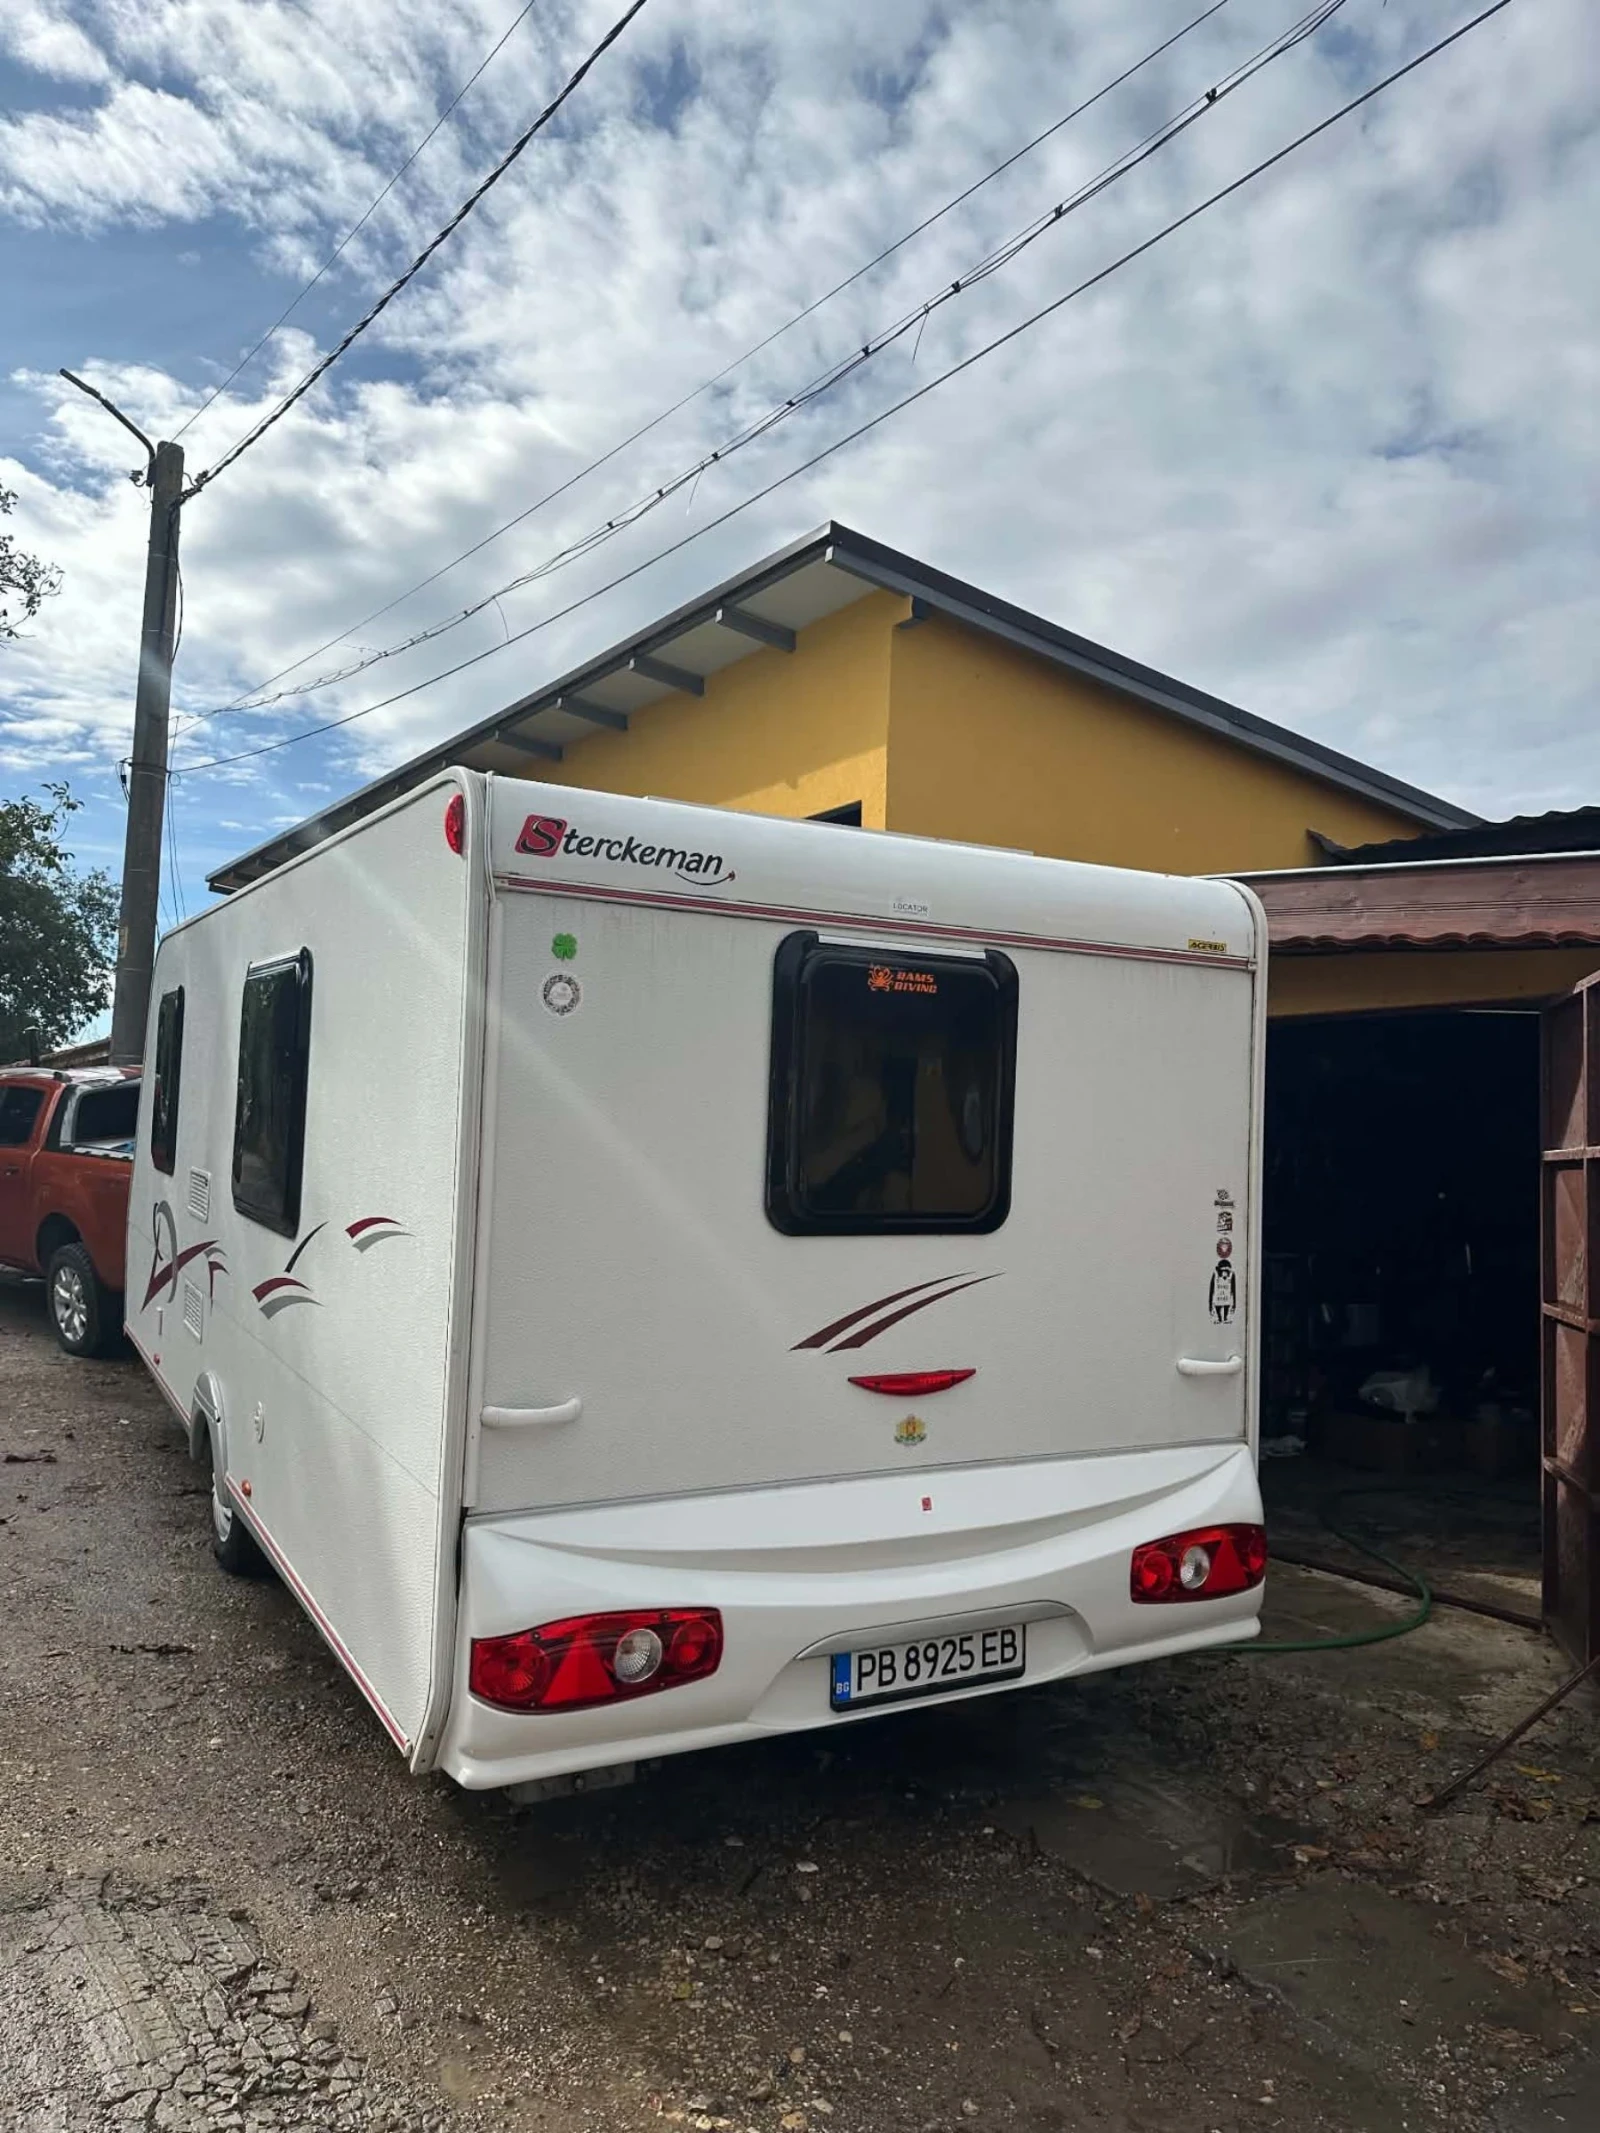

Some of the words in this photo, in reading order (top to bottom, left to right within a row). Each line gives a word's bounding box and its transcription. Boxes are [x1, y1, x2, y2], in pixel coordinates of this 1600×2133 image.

[516, 815, 723, 876] Sterckeman
[892, 902, 929, 913] LOCATOR
[897, 971, 935, 983] RAMS
[894, 981, 938, 994] DIVING
[904, 1635, 975, 1681] 8925
[982, 1629, 1018, 1668] EB
[836, 1681, 850, 1695] BG
